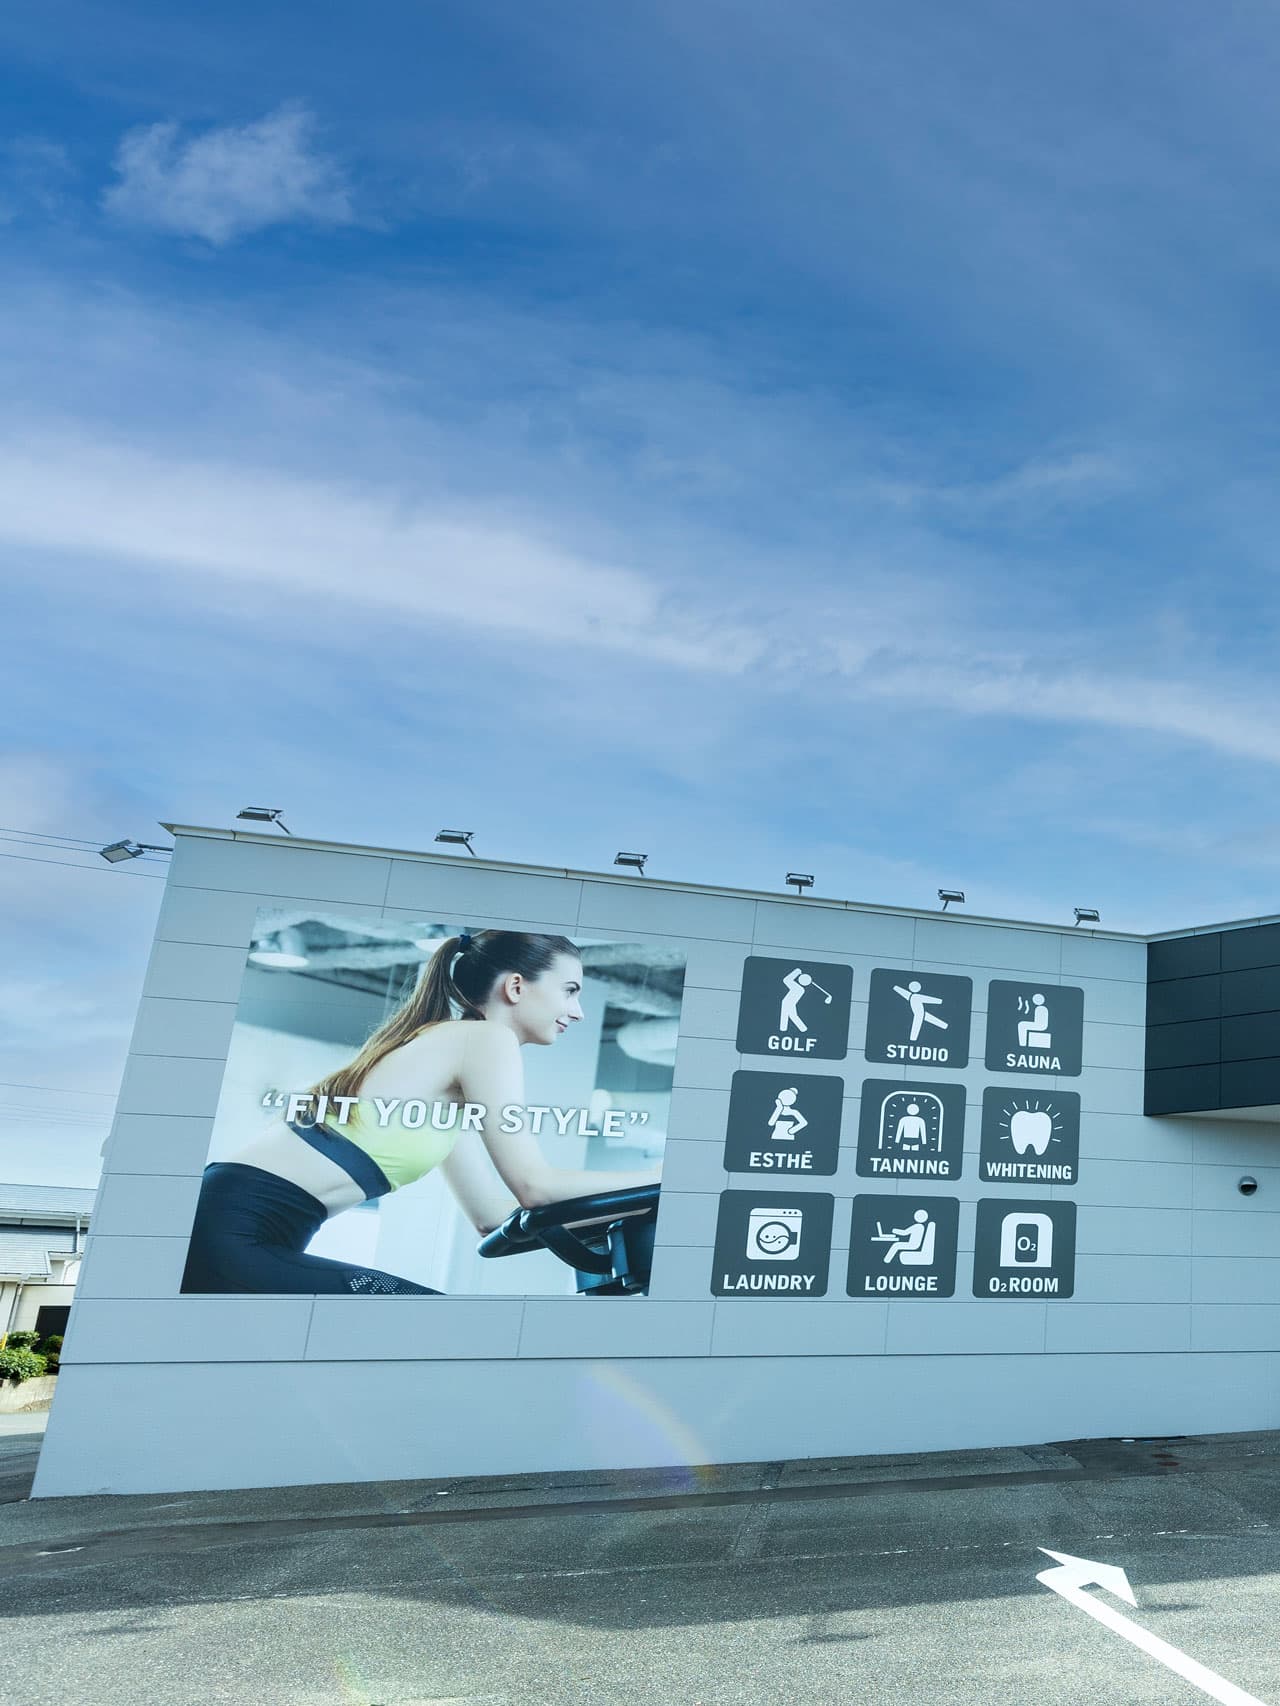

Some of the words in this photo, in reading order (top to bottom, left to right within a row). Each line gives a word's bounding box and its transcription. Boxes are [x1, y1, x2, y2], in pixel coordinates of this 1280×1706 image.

[767, 1035, 817, 1053] GOLF
[886, 1044, 949, 1063] STUDIO
[1006, 1053, 1061, 1071] SAUNA
[373, 1098, 488, 1132] YOUR
[870, 1157, 950, 1176] TANNING
[986, 1162, 1072, 1181] WHITENING
[723, 1273, 816, 1291] LAUNDRY
[864, 1275, 938, 1292] LOUNGE
